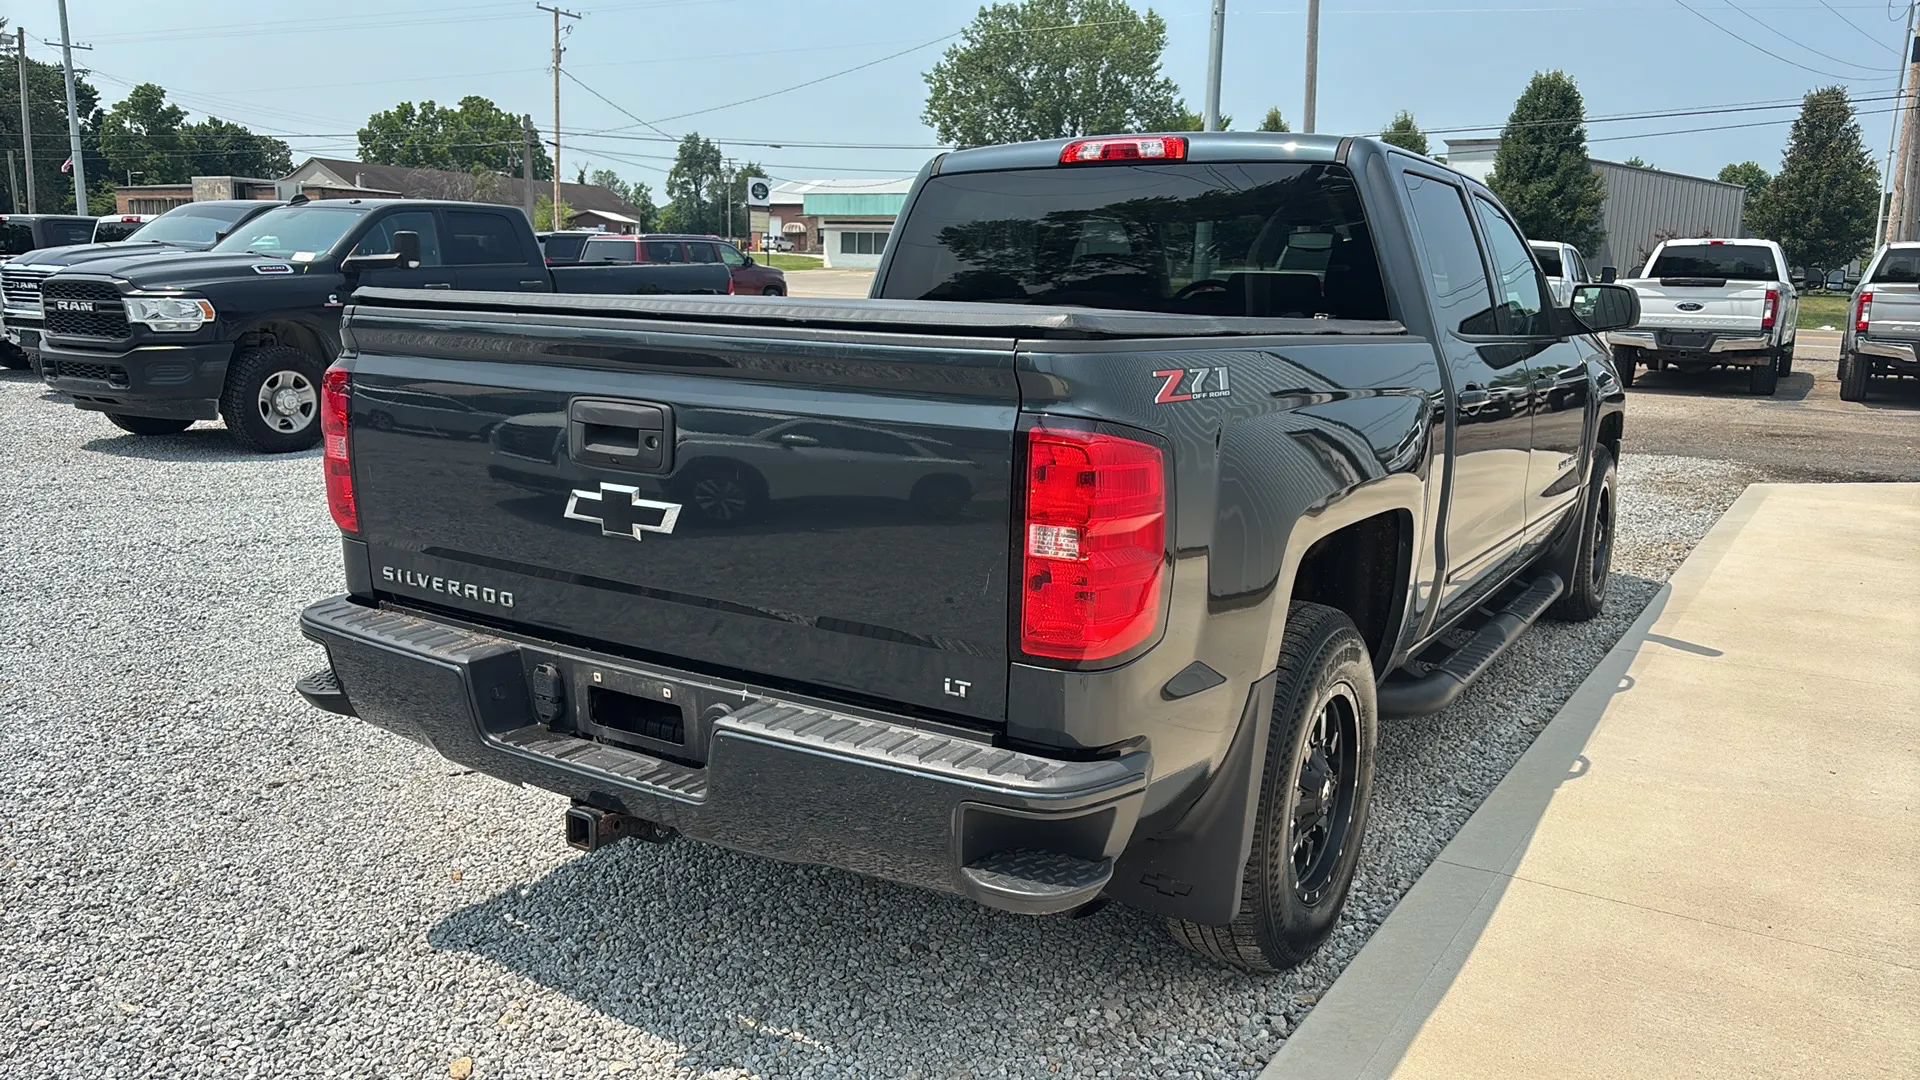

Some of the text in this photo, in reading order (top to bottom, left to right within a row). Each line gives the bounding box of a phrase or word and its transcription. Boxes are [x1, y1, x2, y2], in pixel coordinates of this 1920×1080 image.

[13, 281, 38, 290] RAM
[57, 300, 93, 311] RAM
[1153, 367, 1230, 403] Z71
[1209, 390, 1230, 398] ROAD
[382, 566, 514, 608] SILVERADO
[944, 677, 972, 698] LT
